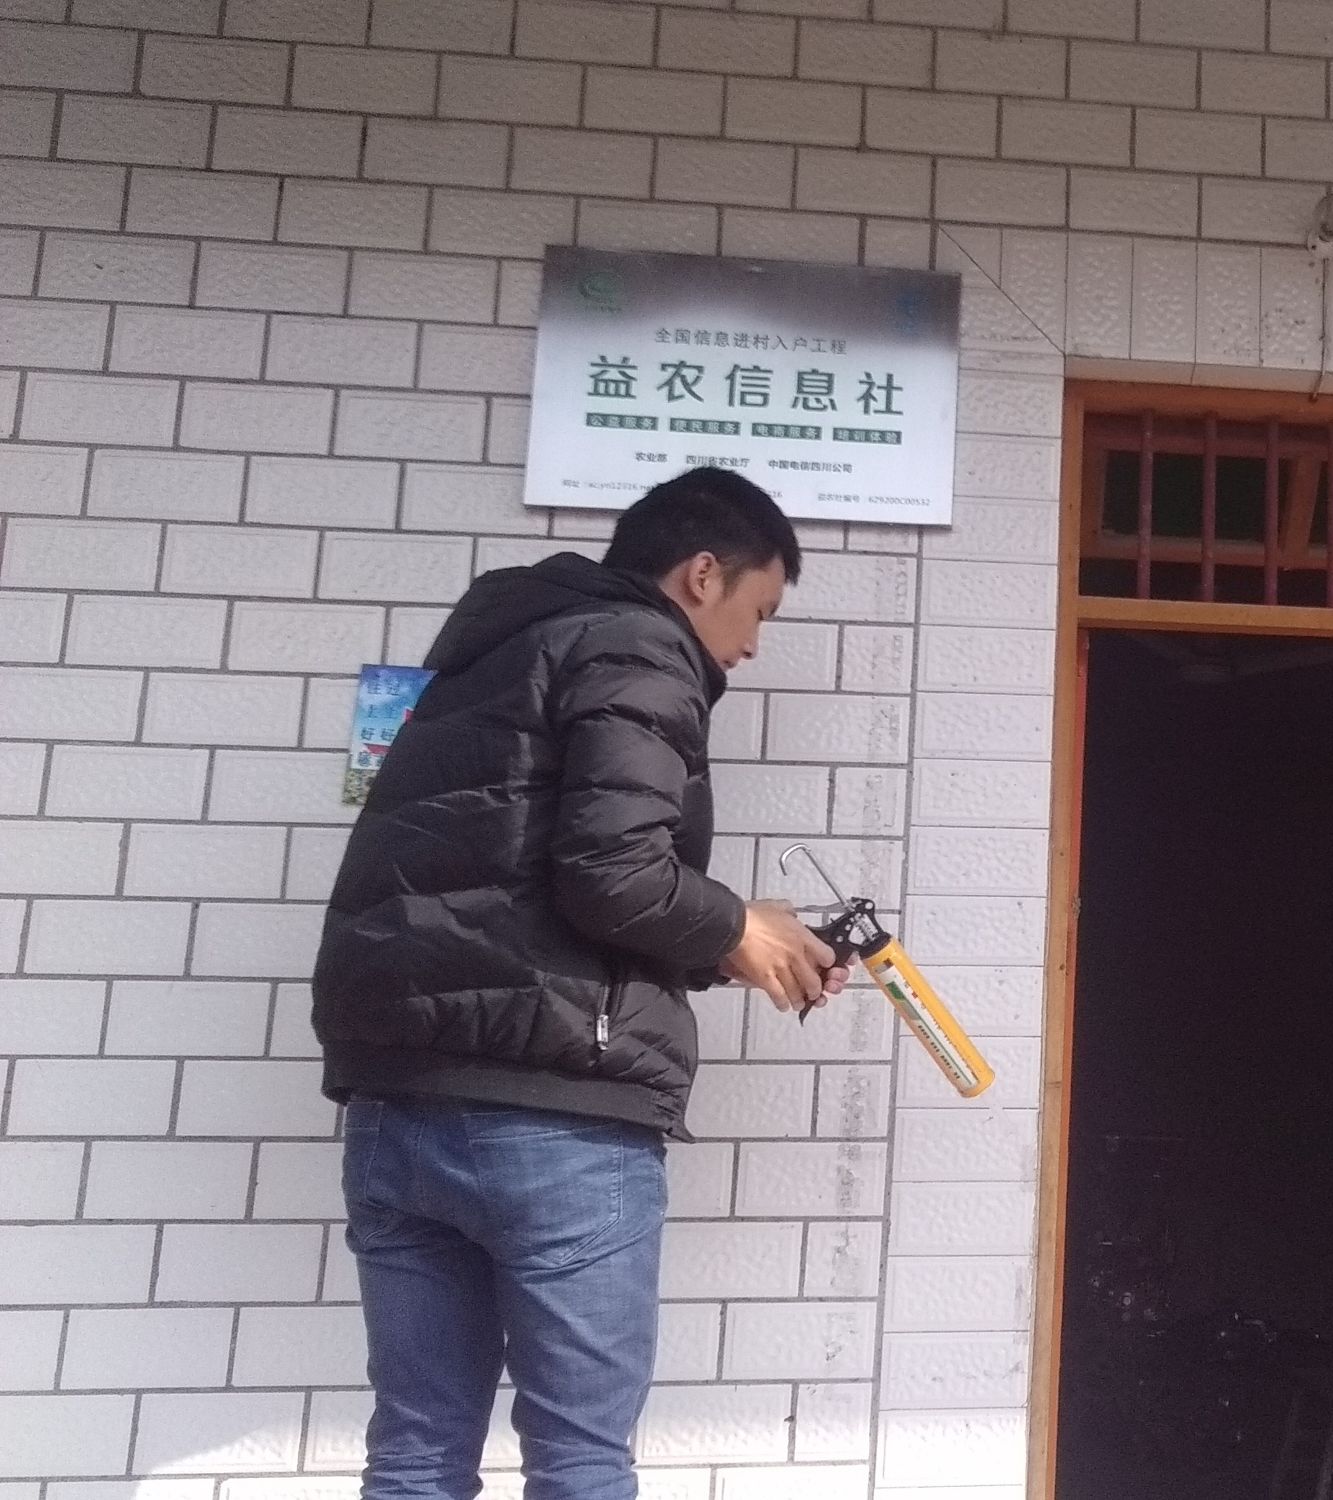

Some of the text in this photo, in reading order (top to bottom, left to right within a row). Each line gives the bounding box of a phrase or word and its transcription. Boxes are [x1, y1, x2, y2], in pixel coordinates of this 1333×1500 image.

[655, 327, 847, 354] 全国信息进村入户工程
[587, 355, 904, 416] 益农信息社
[588, 414, 656, 430] 公益服务
[673, 418, 738, 434] 便民服务
[836, 428, 900, 444] 培训体验
[635, 452, 668, 462] 农业部
[768, 459, 853, 474] 中国电信四川公司
